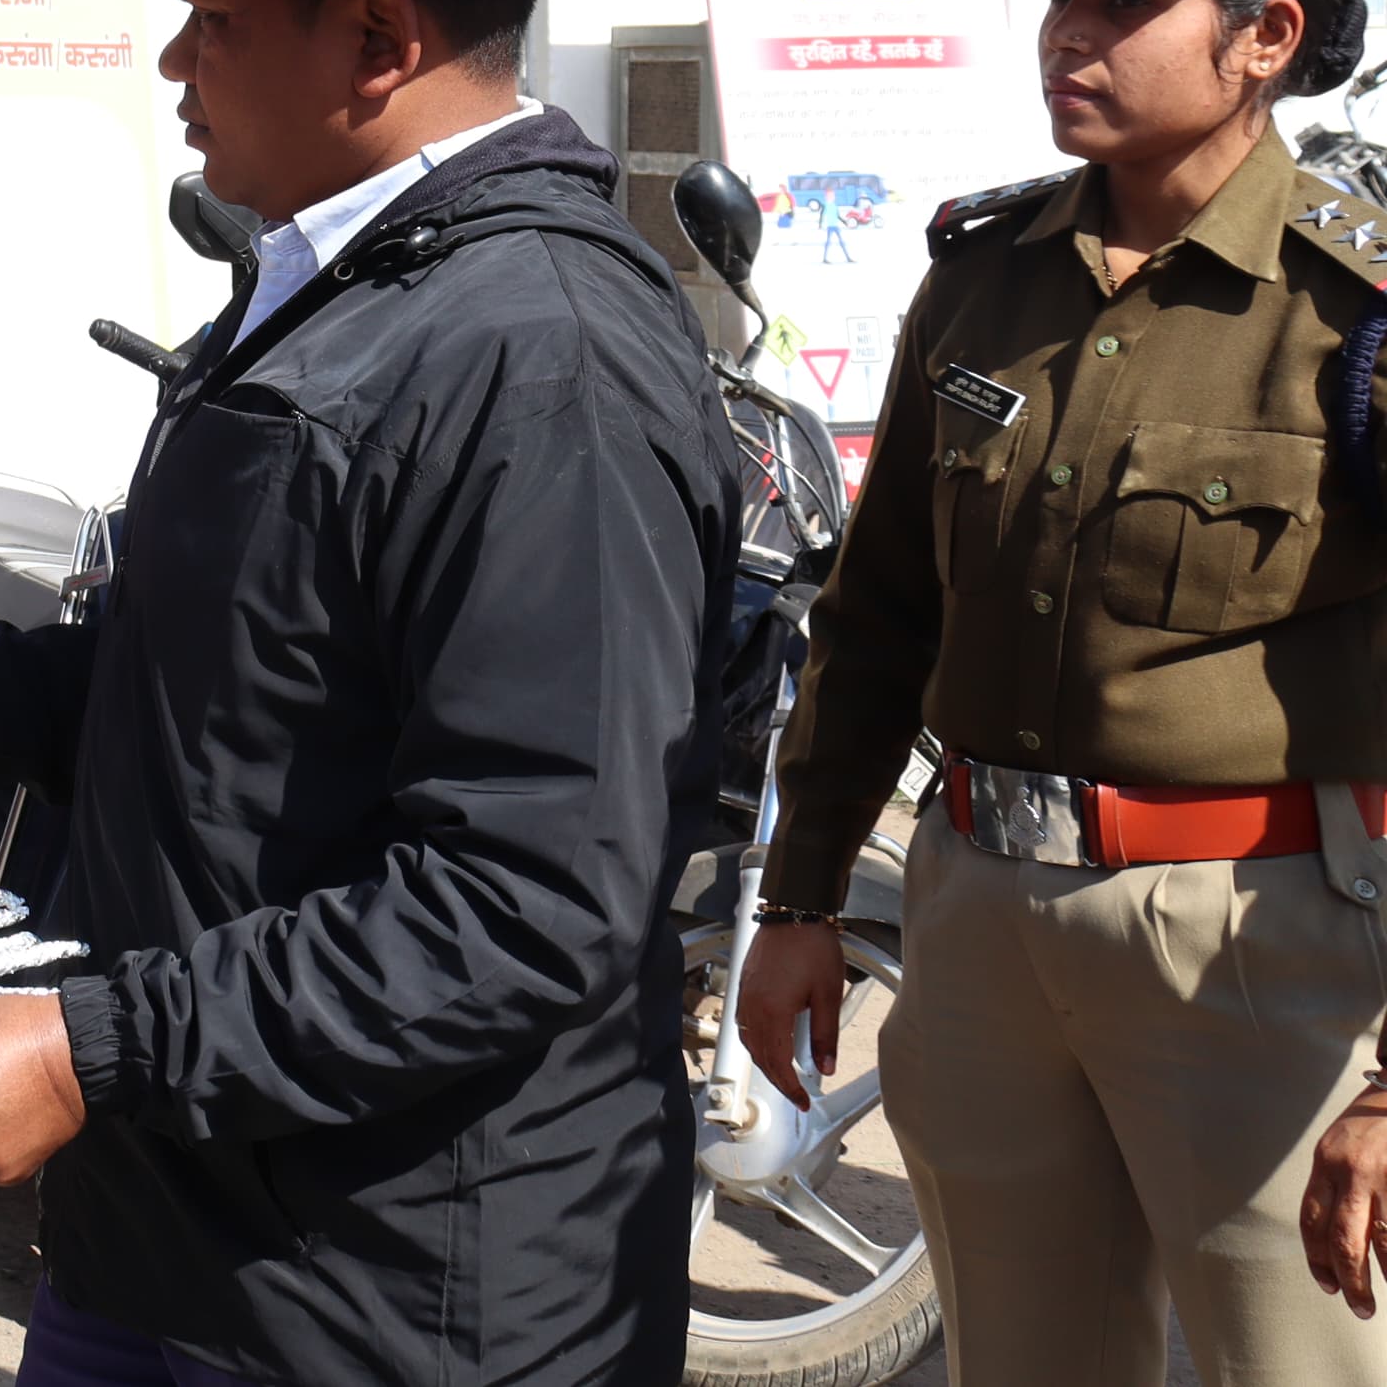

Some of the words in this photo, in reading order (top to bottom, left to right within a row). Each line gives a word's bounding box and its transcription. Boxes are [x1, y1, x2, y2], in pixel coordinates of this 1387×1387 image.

[788, 40, 846, 68] सुरक्षित
[850, 39, 877, 63] रहें,
[878, 39, 921, 61] सतर्क
[923, 38, 944, 63] रहें
